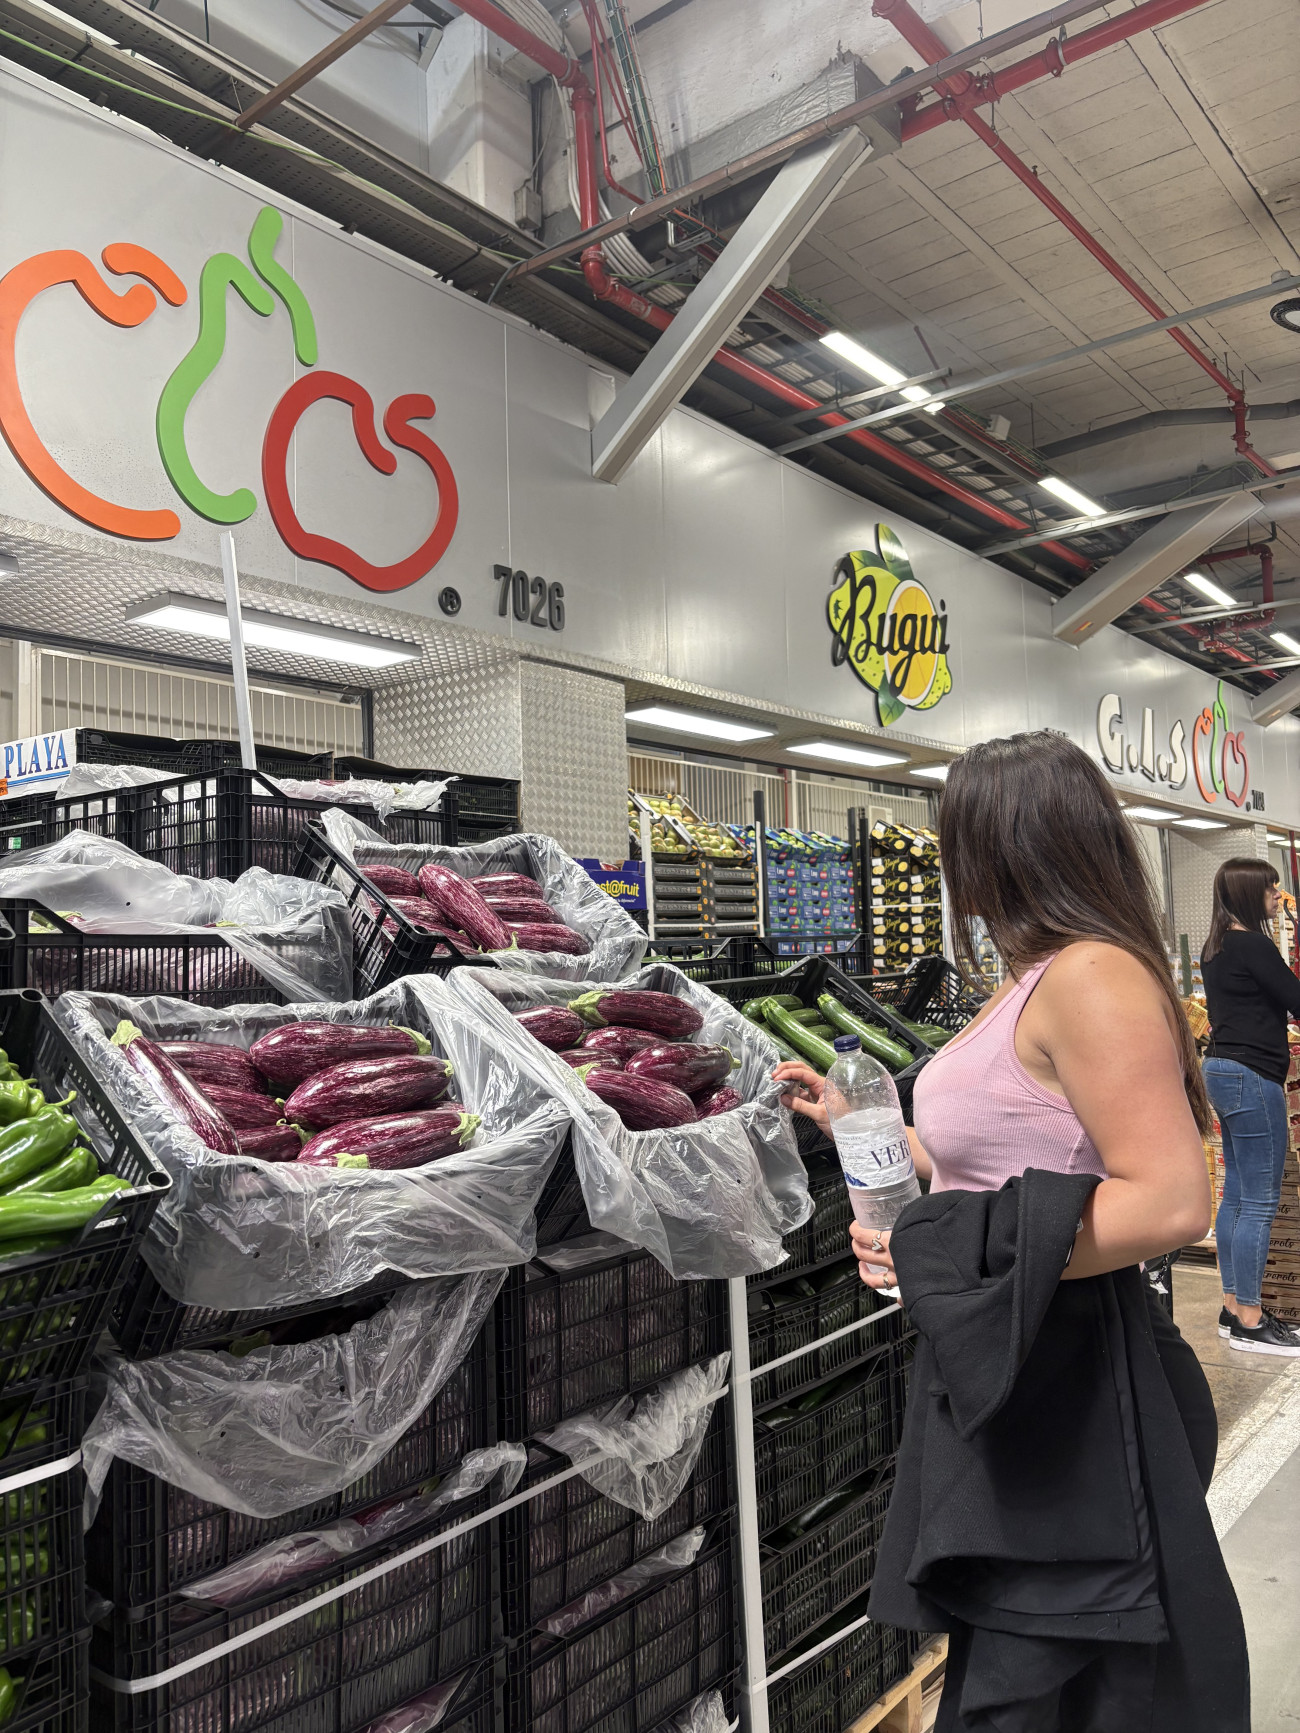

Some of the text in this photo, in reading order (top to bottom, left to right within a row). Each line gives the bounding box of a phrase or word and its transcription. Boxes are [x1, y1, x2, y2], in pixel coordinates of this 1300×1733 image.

[493, 564, 566, 631] 7026
[831, 553, 950, 698] Bugui
[4, 733, 68, 778] PLAYA
